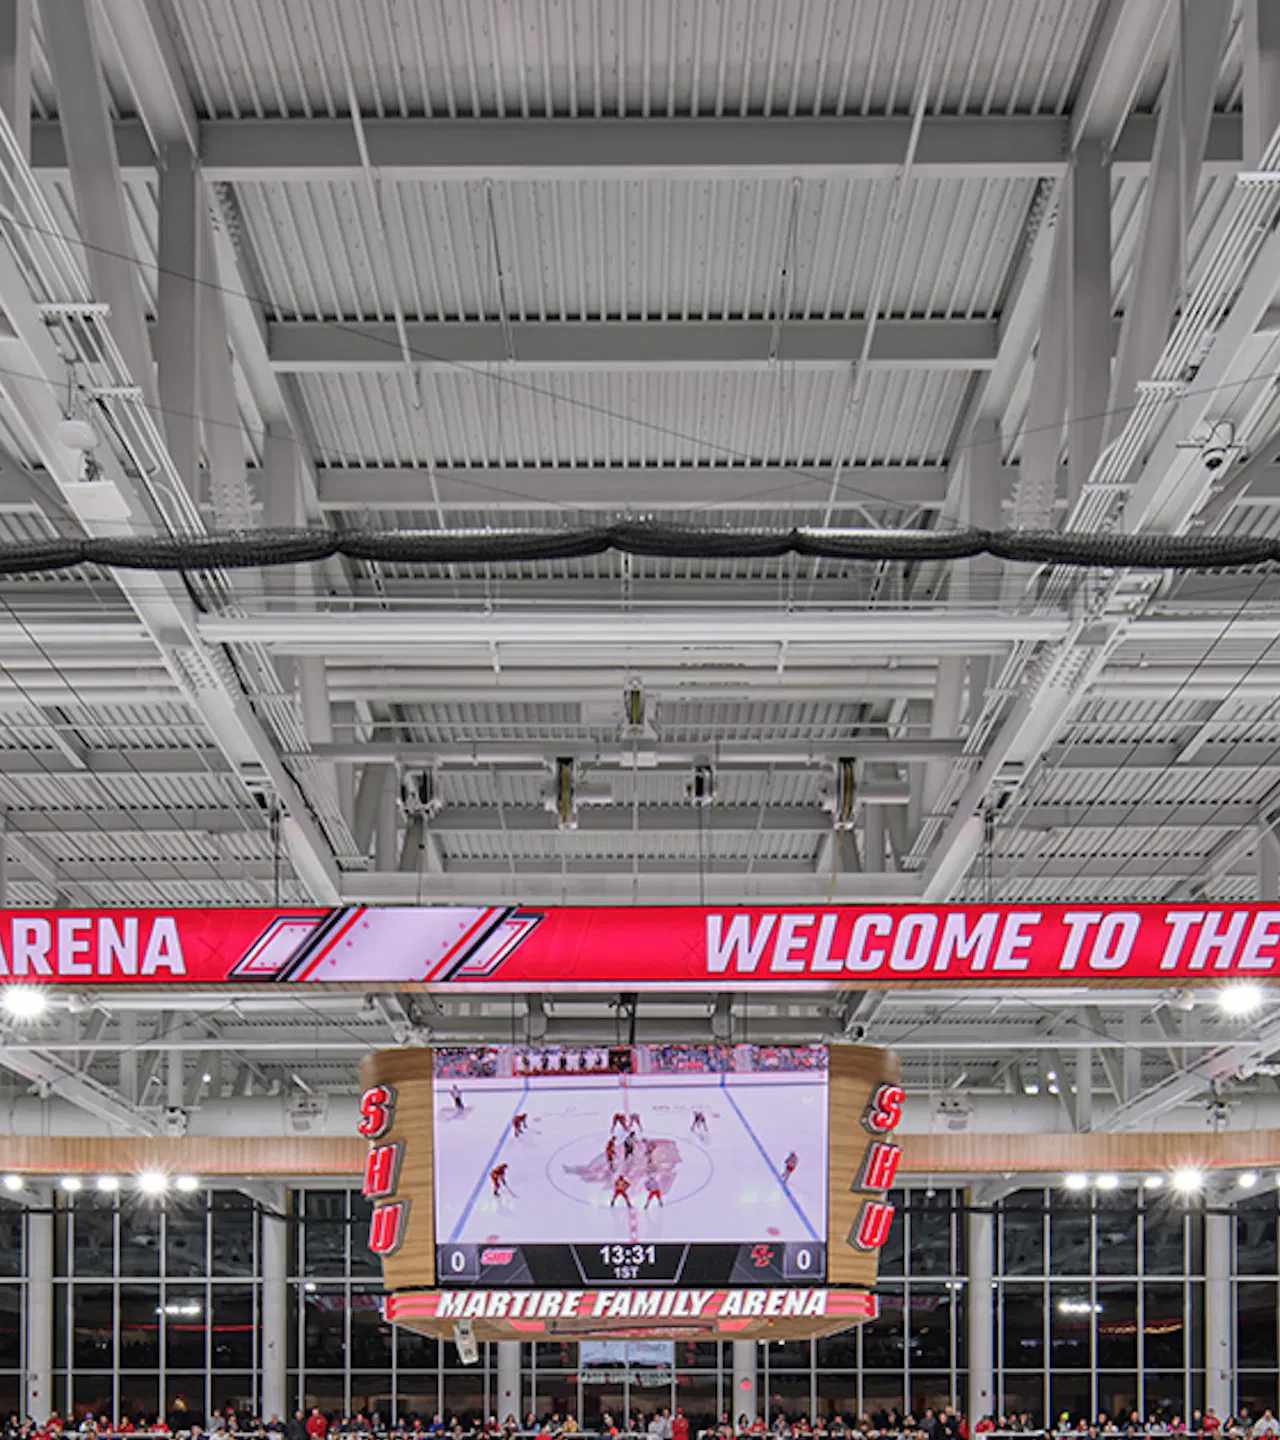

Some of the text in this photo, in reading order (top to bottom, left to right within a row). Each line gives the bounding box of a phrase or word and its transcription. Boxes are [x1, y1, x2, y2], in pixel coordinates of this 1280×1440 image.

[706, 912, 1040, 974] WELCOME
[1059, 911, 1138, 971] TO
[451, 1250, 465, 1272] 0
[599, 1245, 656, 1265] 13:31
[796, 1249, 812, 1270] 0
[613, 1266, 639, 1279] 1ST
[434, 1289, 829, 1318] MARTIRE FAMILY ARENA
